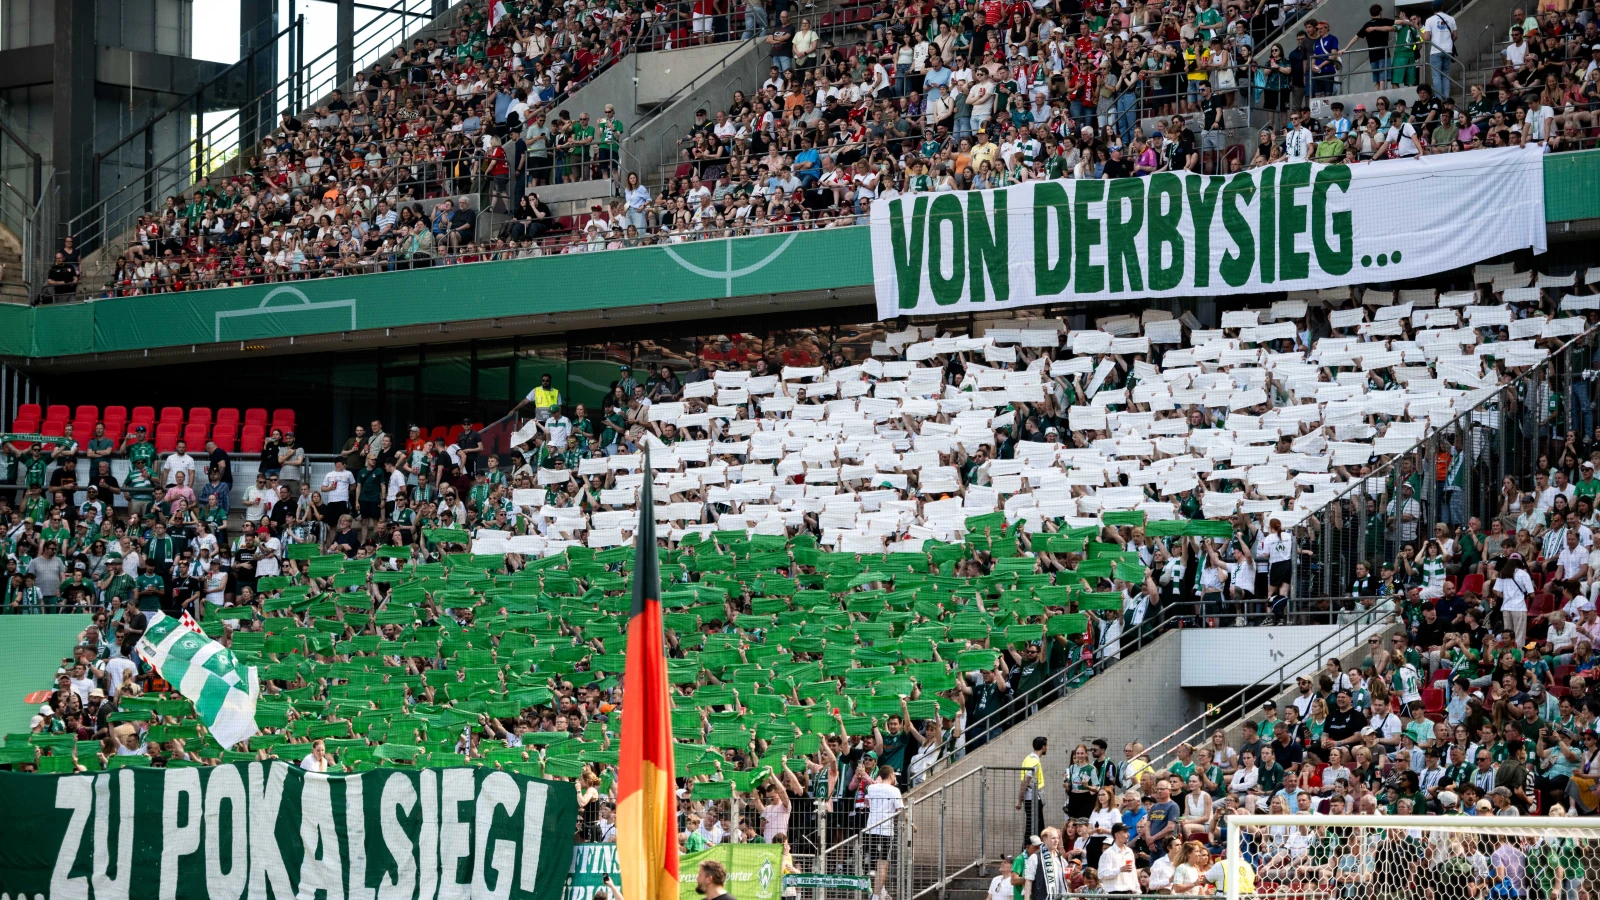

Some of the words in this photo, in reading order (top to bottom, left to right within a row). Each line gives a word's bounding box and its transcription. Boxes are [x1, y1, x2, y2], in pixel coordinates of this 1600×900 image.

[889, 189, 1009, 310] VON
[1033, 161, 1403, 296] DERBYSIEG...
[161, 761, 548, 900] POKALSIEG!
